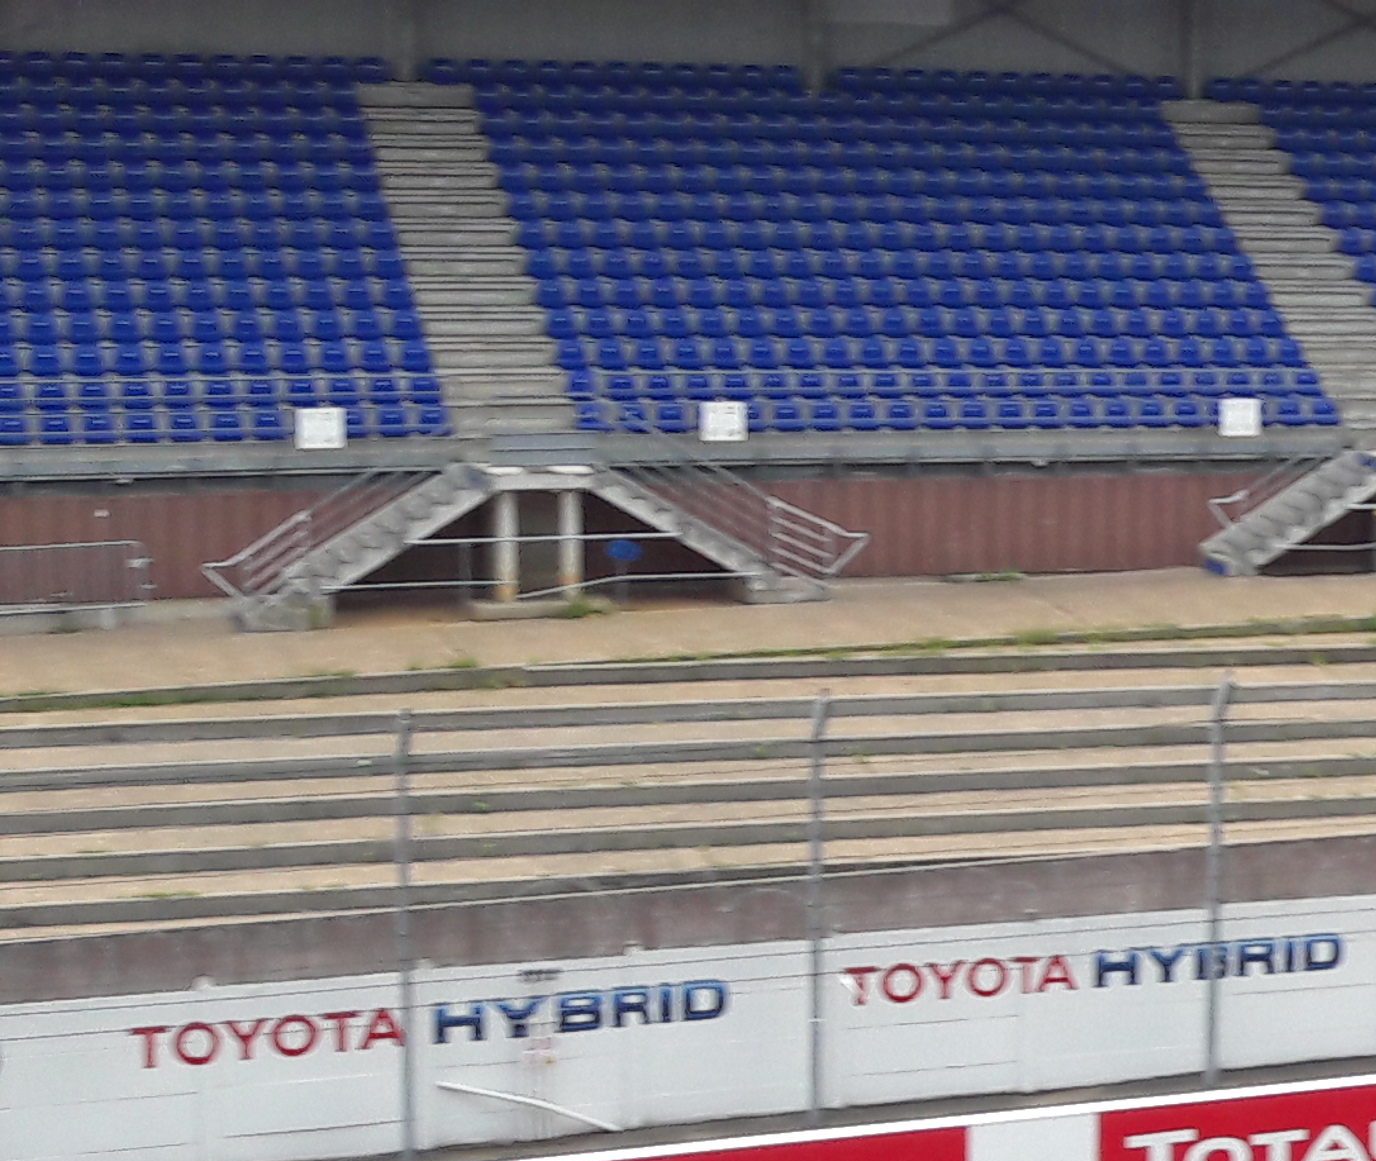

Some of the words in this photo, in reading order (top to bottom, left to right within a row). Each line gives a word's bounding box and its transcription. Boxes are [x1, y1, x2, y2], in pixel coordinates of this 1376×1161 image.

[840, 953, 1080, 1008] TOYOTA
[1091, 932, 1347, 990] HYBRID
[131, 1007, 406, 1070] TOYOTA
[433, 979, 731, 1045] HYBRID
